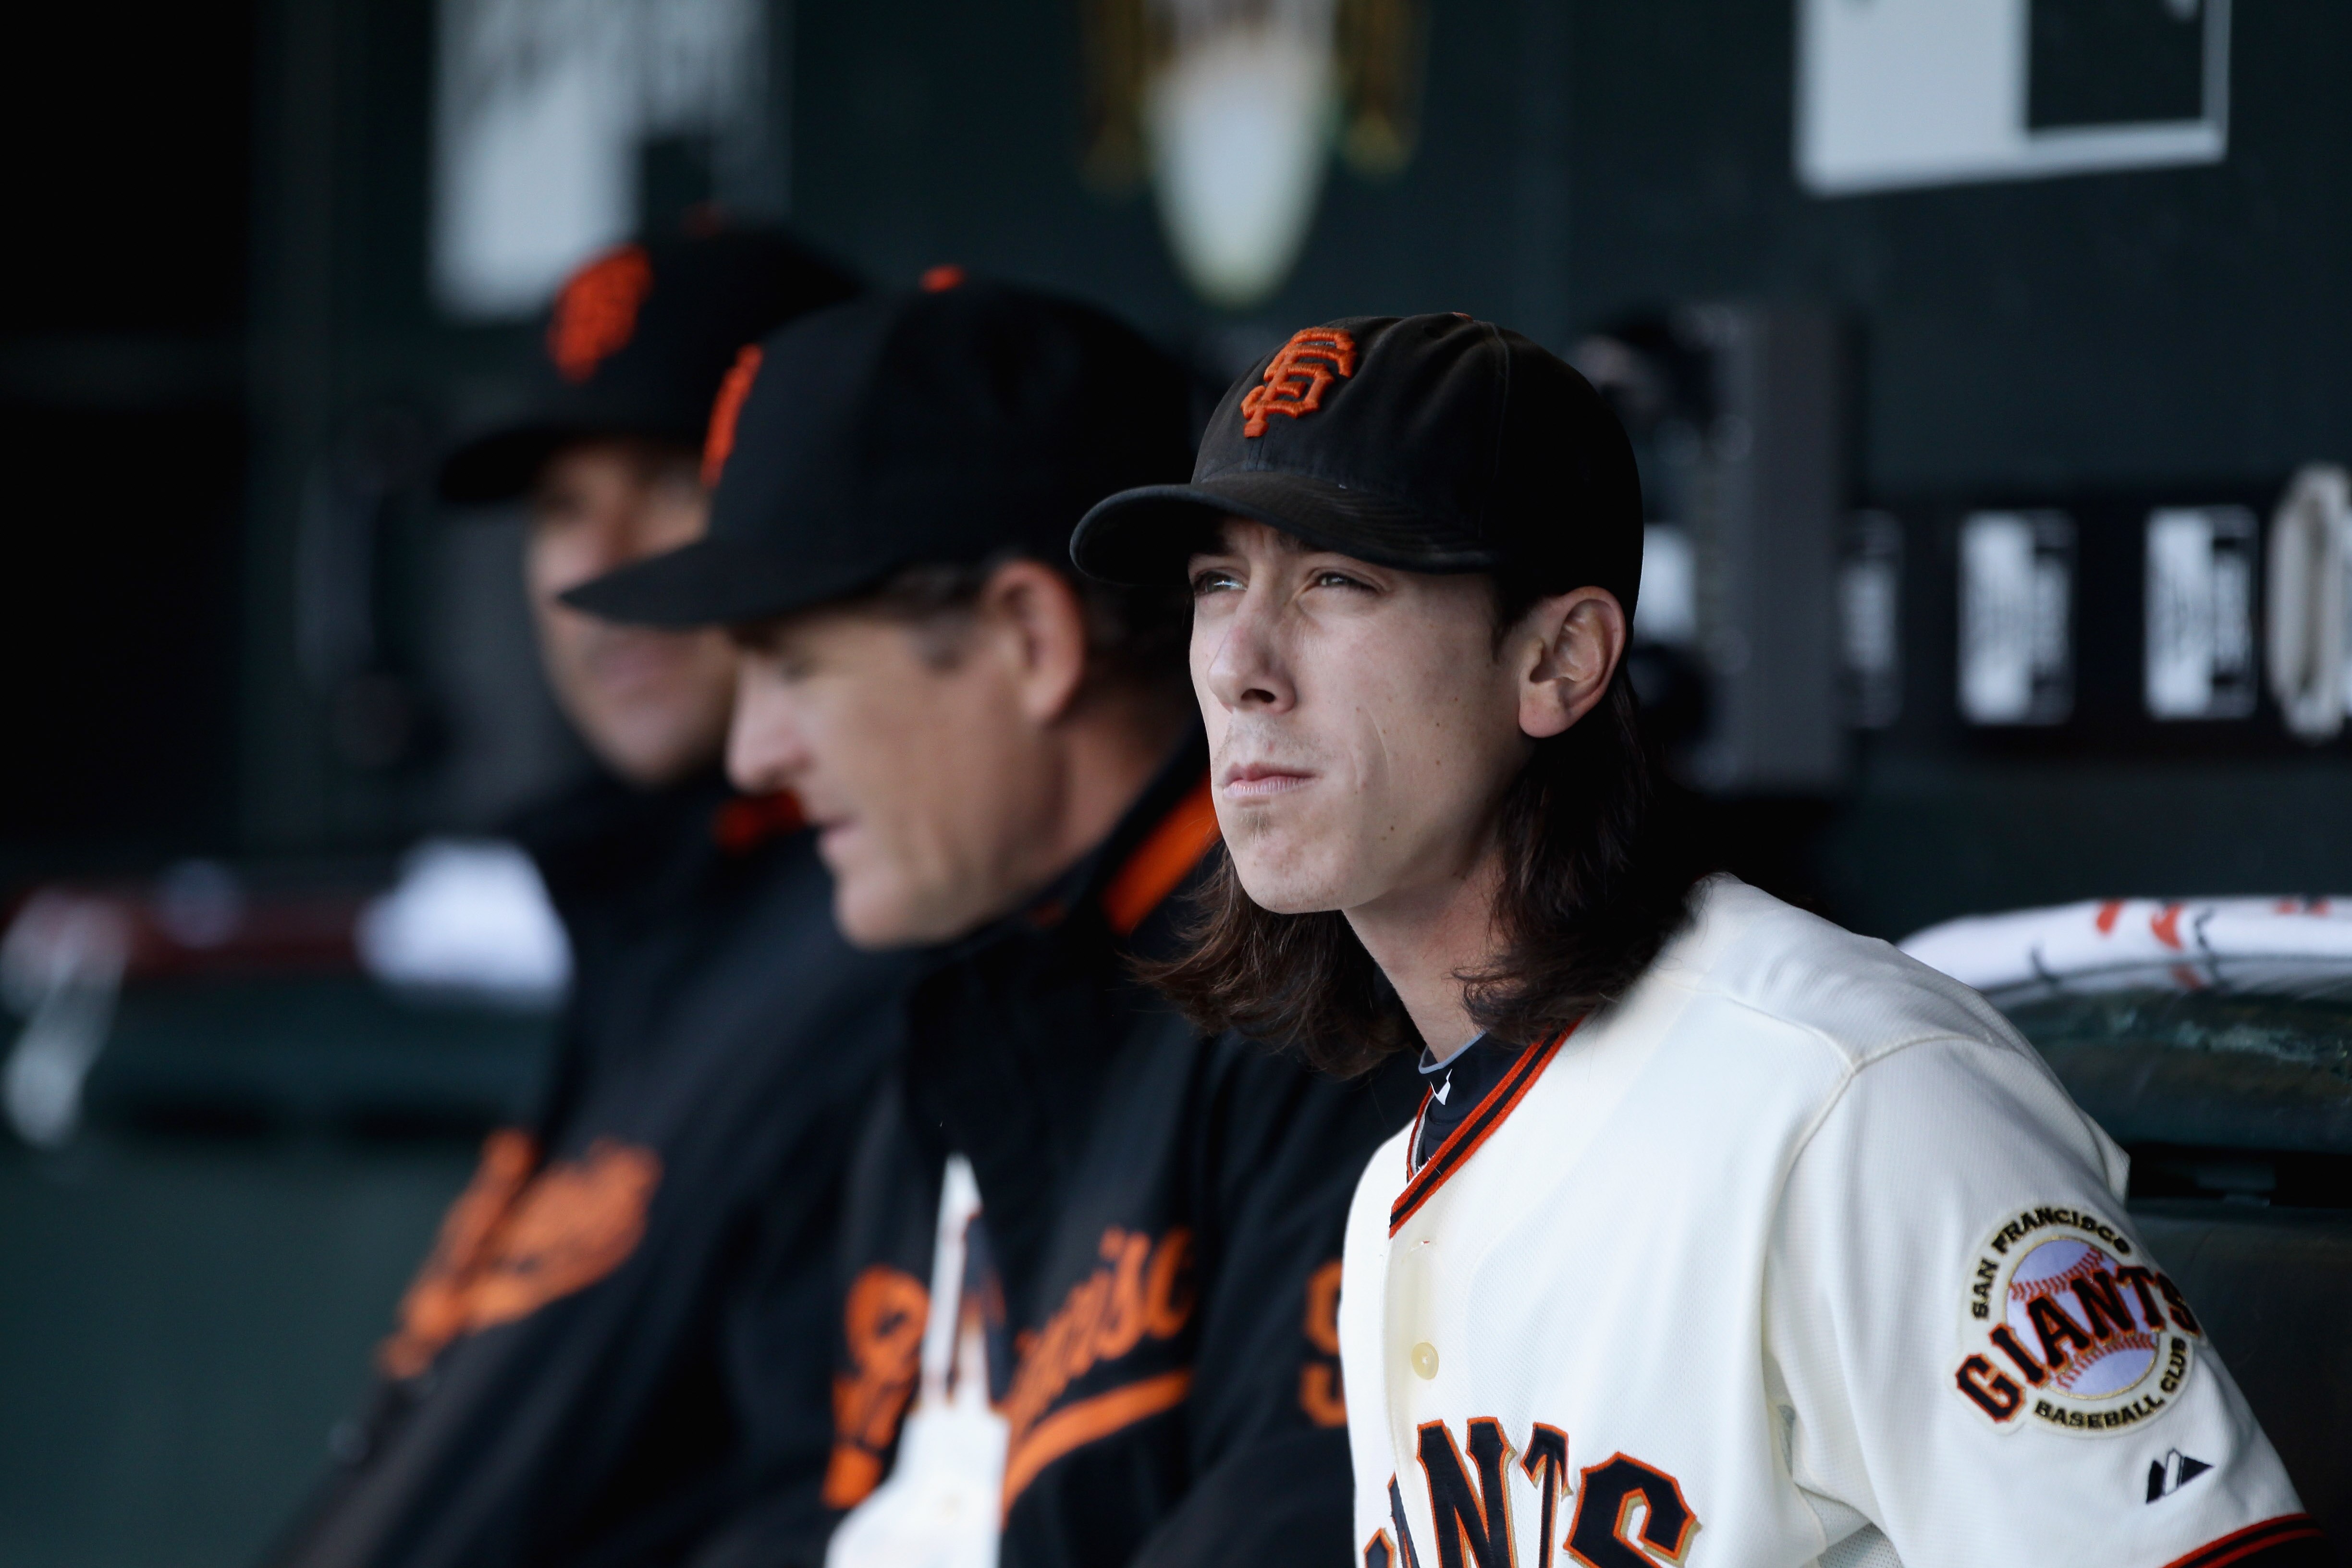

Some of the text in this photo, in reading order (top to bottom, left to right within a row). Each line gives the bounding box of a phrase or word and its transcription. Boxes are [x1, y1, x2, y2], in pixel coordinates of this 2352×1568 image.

[1972, 1207, 2131, 1320] SAN FRANCISCO
[1956, 1265, 2200, 1423] GIANTS
[2034, 1337, 2187, 1429] BASEBALL CLUB
